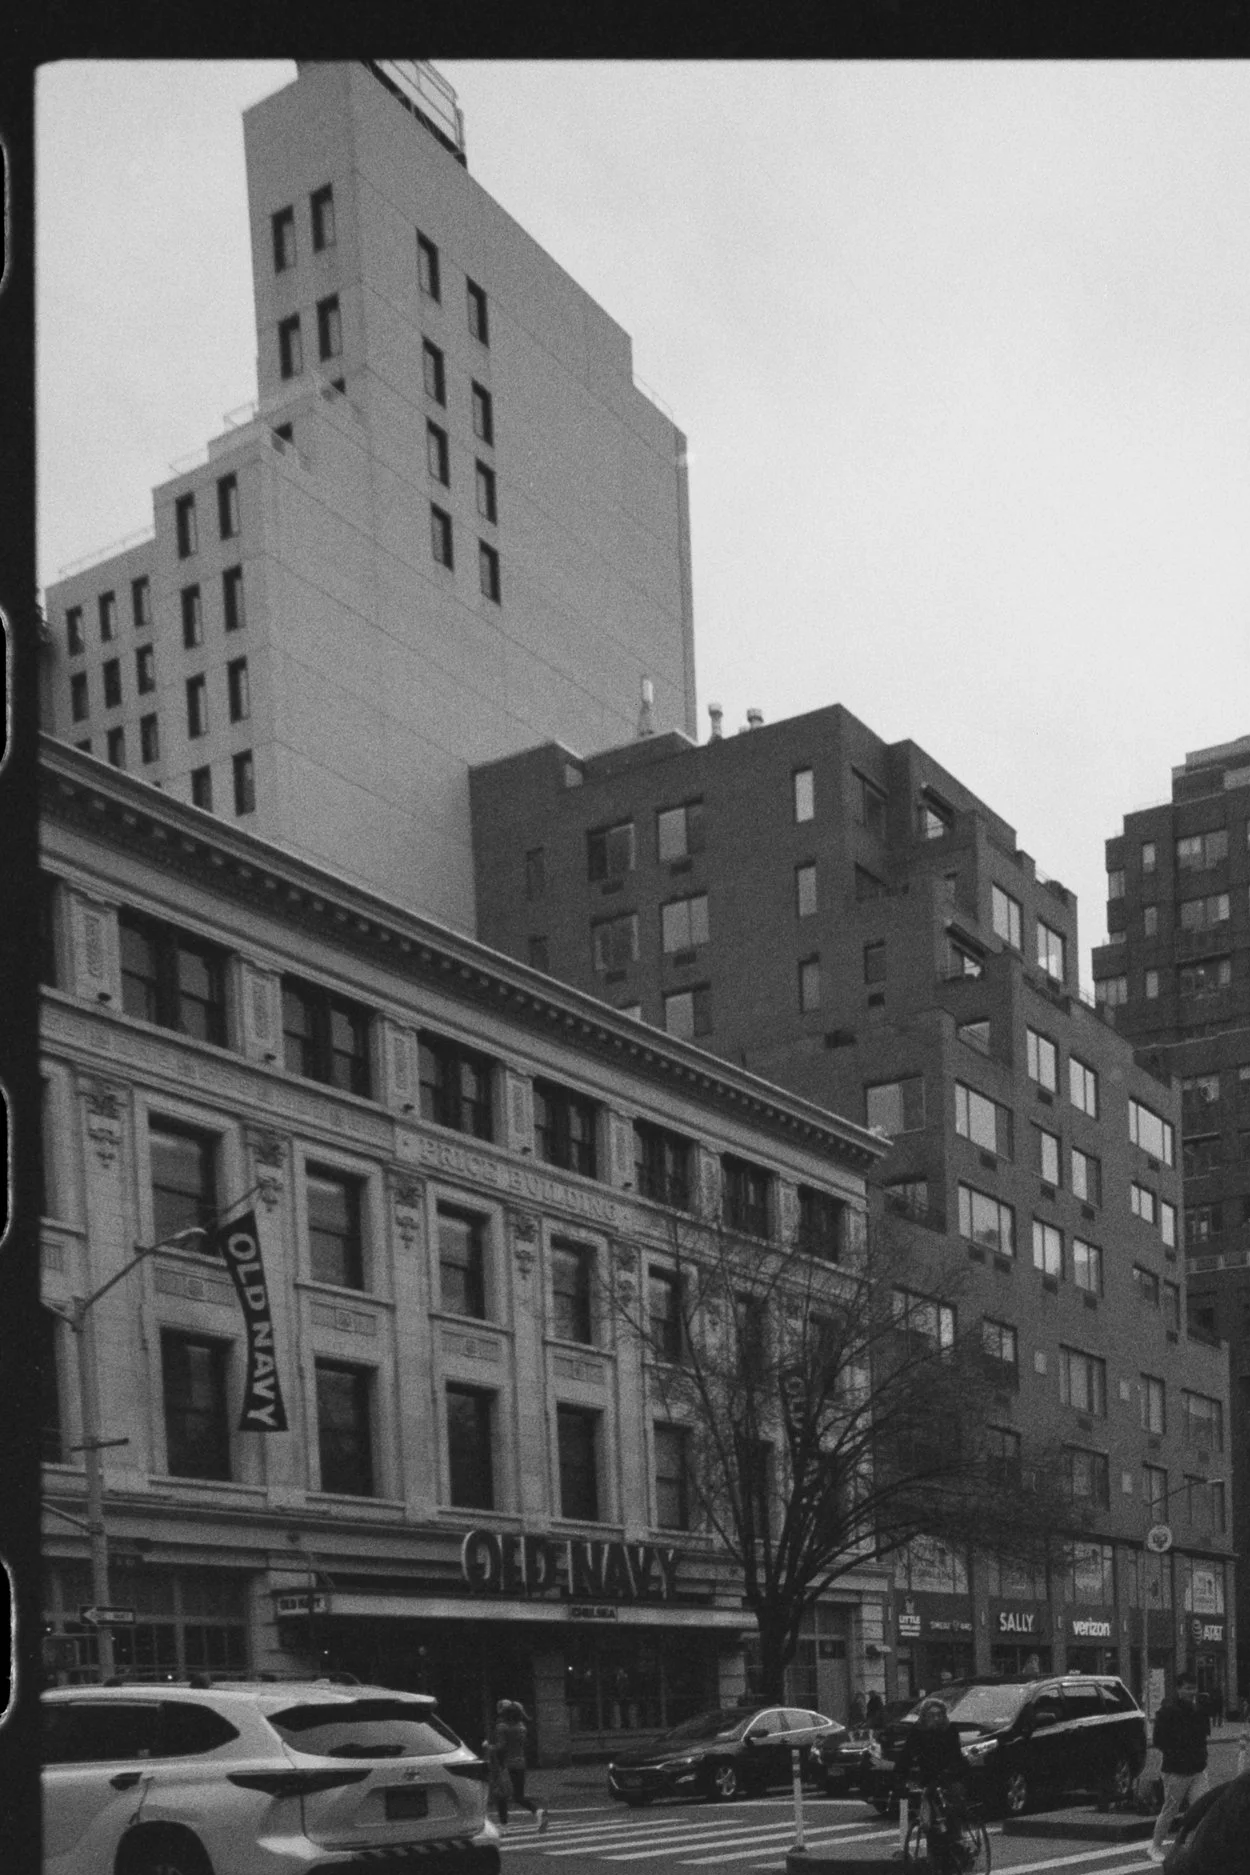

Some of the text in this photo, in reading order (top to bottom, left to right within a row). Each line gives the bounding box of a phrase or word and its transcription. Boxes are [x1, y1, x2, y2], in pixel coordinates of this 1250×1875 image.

[420, 1137, 616, 1223] PRICE BUILDING
[228, 1232, 278, 1427] OLD NAVY
[460, 1529, 682, 1601] OLD NAVY
[1000, 1611, 1035, 1632] SALLY
[1072, 1618, 1112, 1637] verizon
[1204, 1624, 1223, 1641] AT&T
